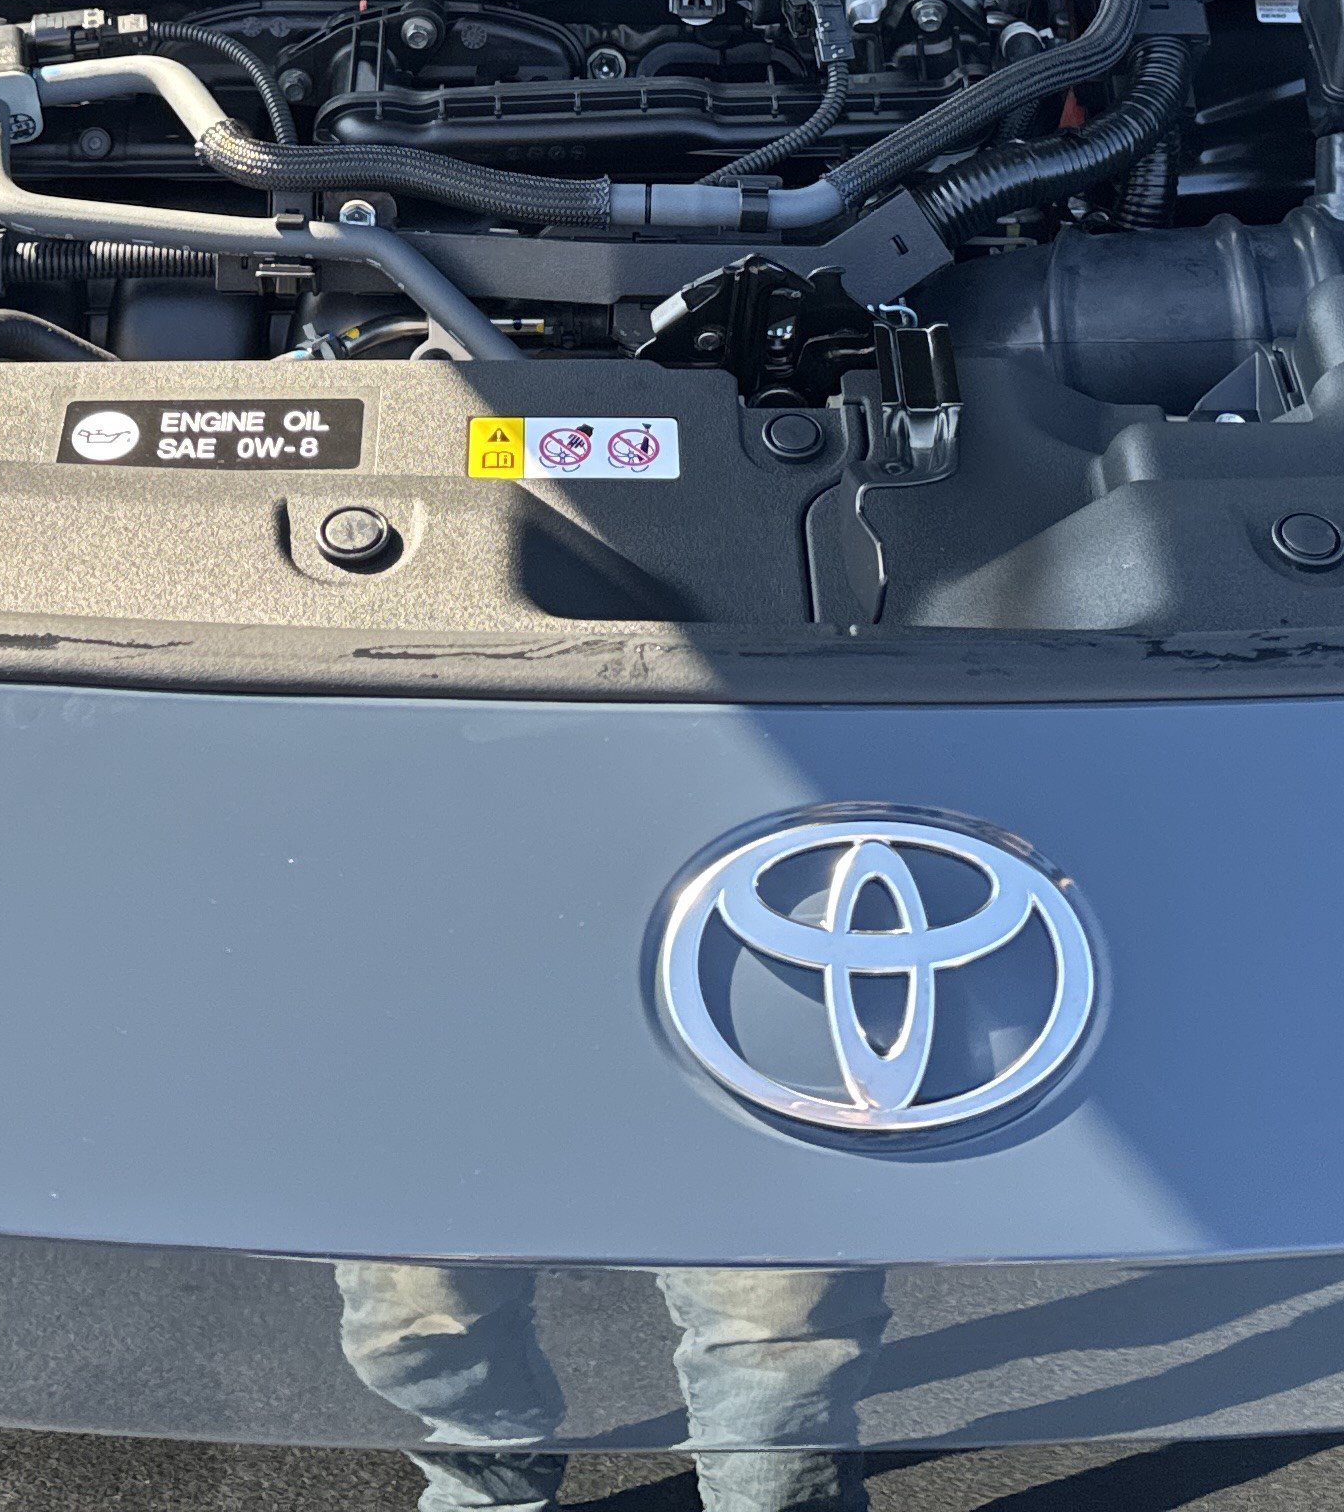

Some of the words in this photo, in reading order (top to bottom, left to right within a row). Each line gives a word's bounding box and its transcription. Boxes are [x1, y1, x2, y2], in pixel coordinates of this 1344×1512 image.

[160, 411, 265, 433] ENGINE
[283, 410, 330, 432] OIL
[156, 437, 217, 460] SAE
[237, 437, 319, 459] 0W-8
